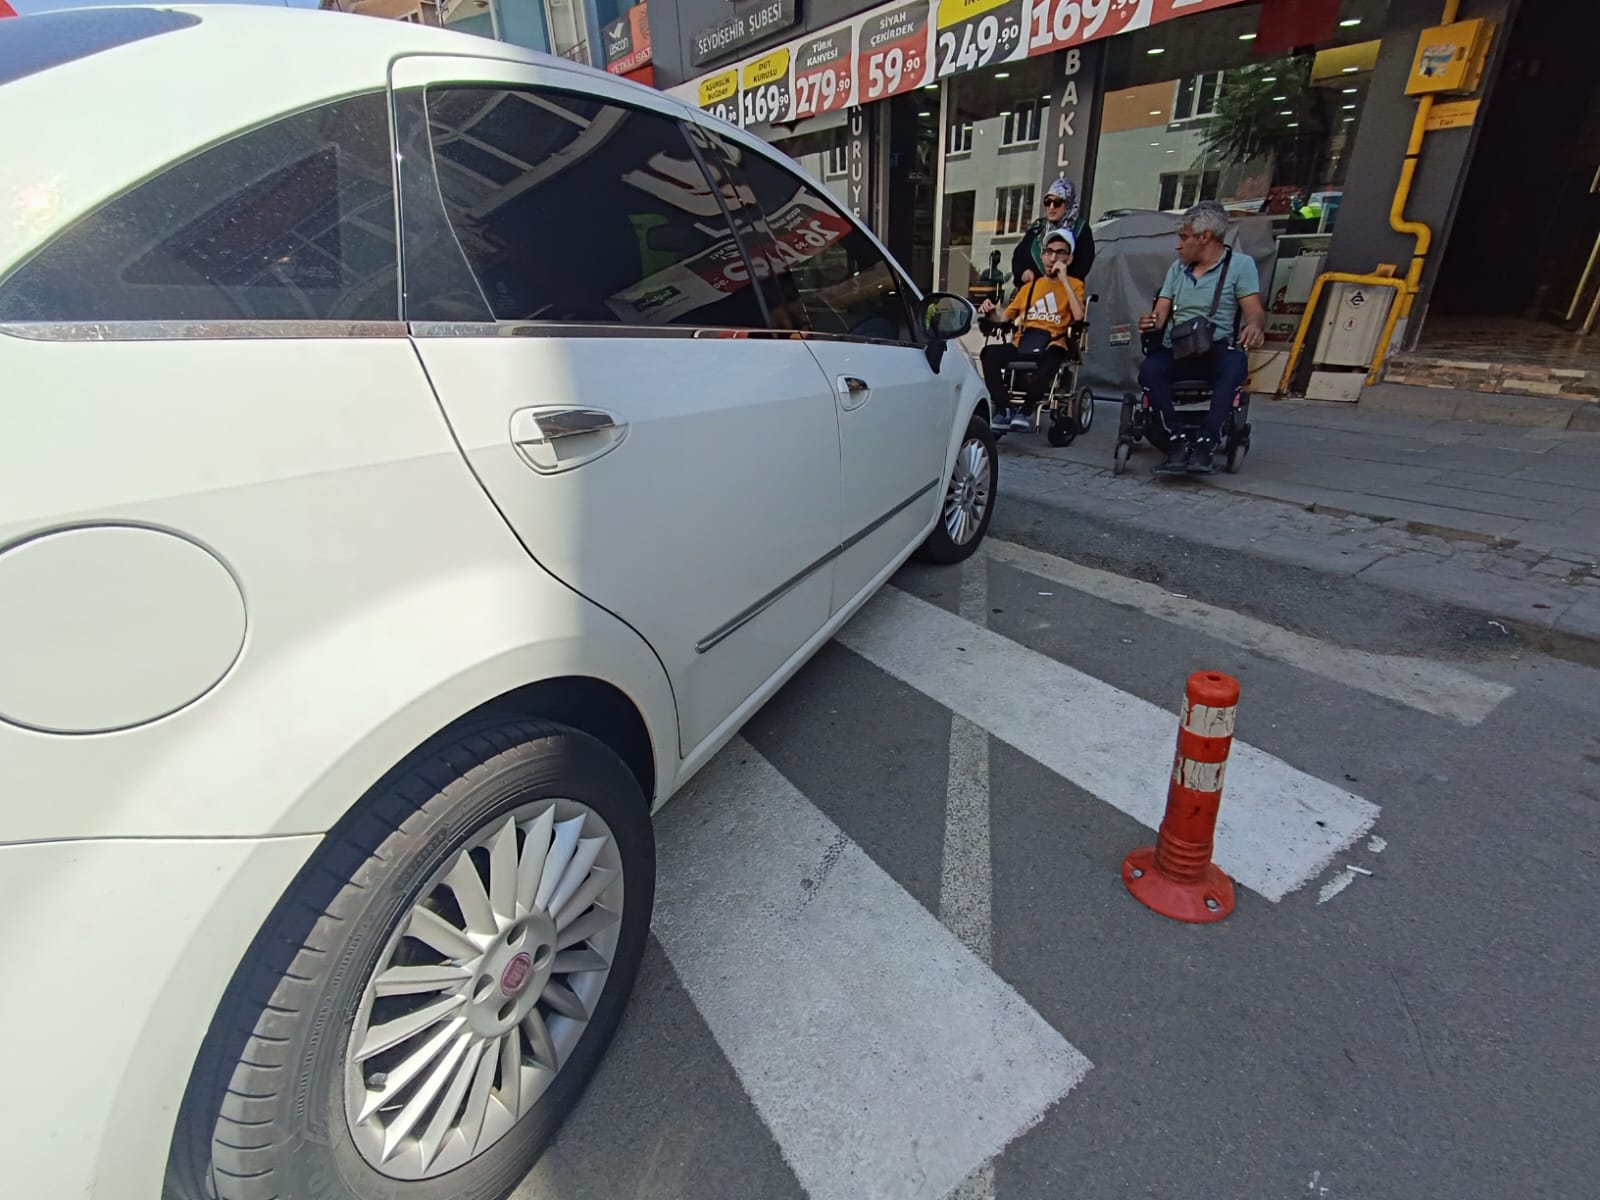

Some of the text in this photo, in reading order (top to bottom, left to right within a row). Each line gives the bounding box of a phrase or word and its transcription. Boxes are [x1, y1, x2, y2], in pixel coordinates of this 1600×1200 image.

[698, 0, 782, 55] SEYDİŞEHİR ŞUBESİ
[870, 21, 915, 47] ÇEKİRDEK
[880, 11, 906, 29] SİYAH
[806, 47, 838, 67] KAHVESİ
[812, 39, 833, 53] TÜRK
[938, 15, 1019, 77] 249.90
[758, 60, 772, 71] DUT
[868, 47, 920, 98] 59.90
[796, 69, 850, 113] 279.90
[1057, 48, 1081, 178] BAKL
